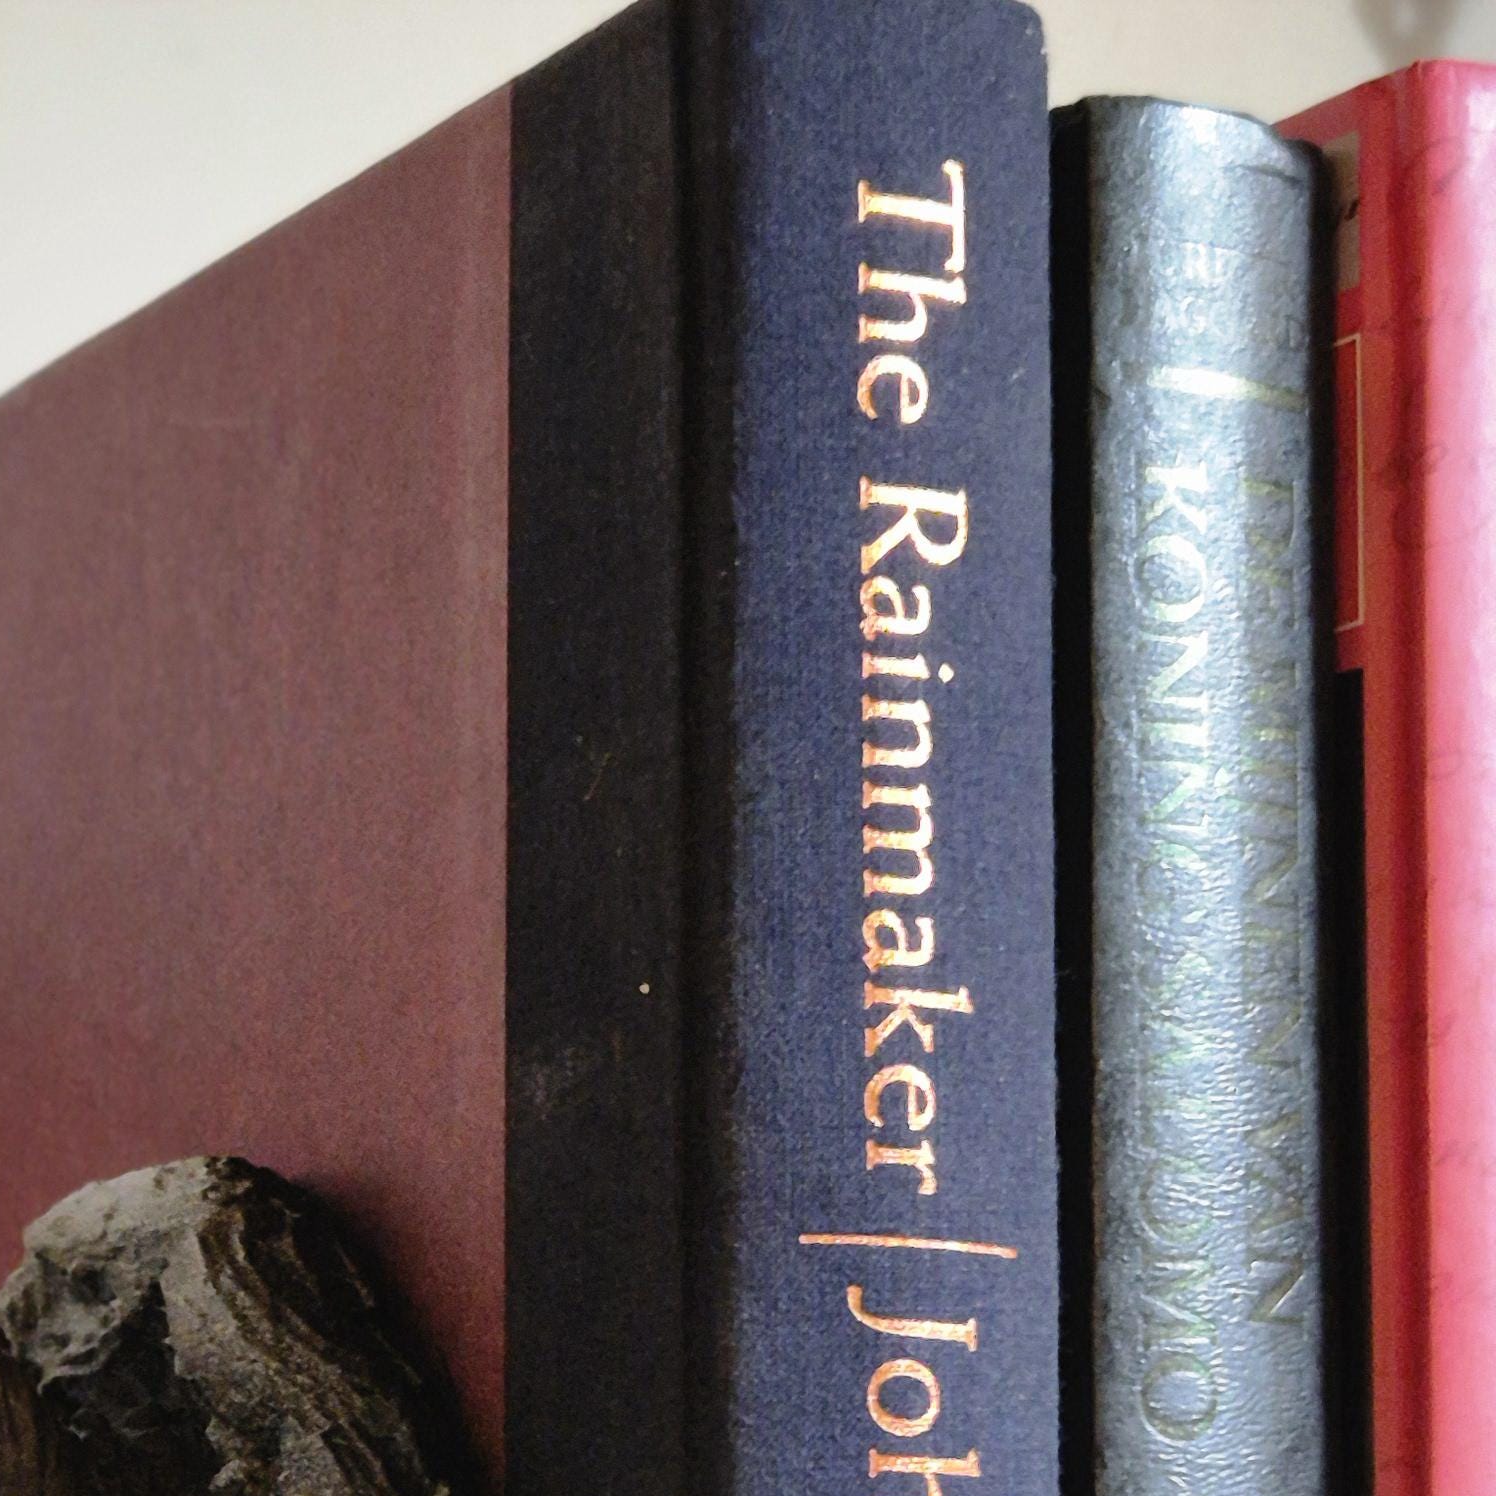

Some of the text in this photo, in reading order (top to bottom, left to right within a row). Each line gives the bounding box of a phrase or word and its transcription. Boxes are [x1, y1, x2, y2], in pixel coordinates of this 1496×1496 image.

[856, 159, 967, 424] The
[859, 476, 974, 1196] Rainmaker
[1136, 455, 1210, 926] KONING
[1244, 1111, 1307, 1324] VAN
